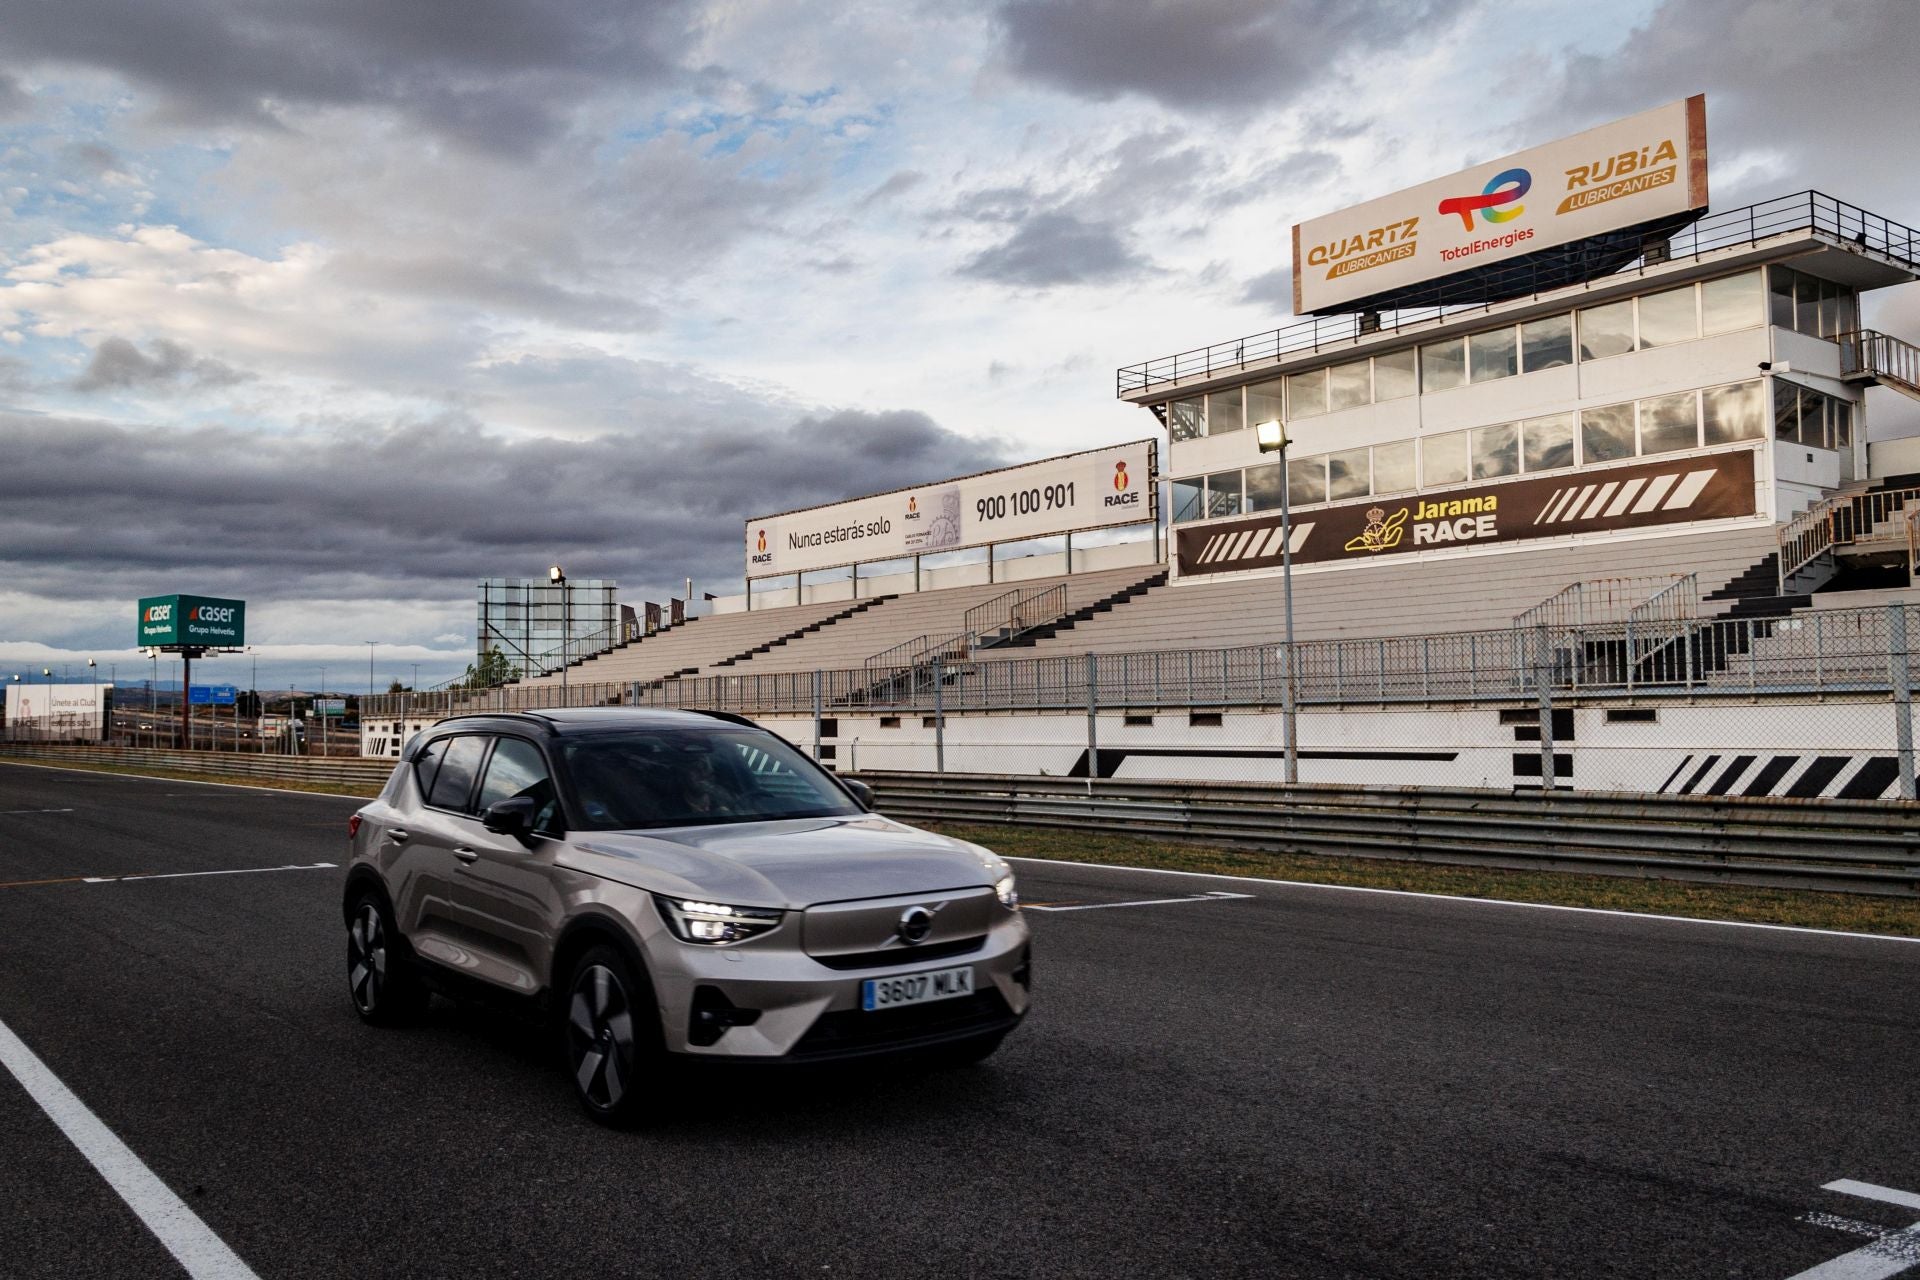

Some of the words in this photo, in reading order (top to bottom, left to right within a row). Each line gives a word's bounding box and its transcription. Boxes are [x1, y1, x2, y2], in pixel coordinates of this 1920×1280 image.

[1569, 169, 1671, 209] LUBRICANTES
[1307, 216, 1420, 266] QUARTZ
[1440, 228, 1534, 262] TotalEnergies
[1336, 244, 1412, 276] LUBRICANTES
[976, 494, 1006, 522] 900
[1010, 488, 1041, 516] 100
[1044, 481, 1075, 511] 901
[1104, 491, 1139, 507] RACE
[1413, 495, 1498, 521] Jarama
[904, 512, 921, 520] RACE
[1413, 514, 1499, 545] RACE
[789, 532, 822, 550] Nunca
[823, 520, 865, 544] estarás
[866, 516, 891, 537] solo
[752, 553, 772, 563] RACE
[149, 604, 172, 622] caser
[198, 606, 235, 623] caser
[188, 624, 209, 636] Grupo
[878, 976, 929, 1004] 3607
[932, 970, 970, 996] MLK
